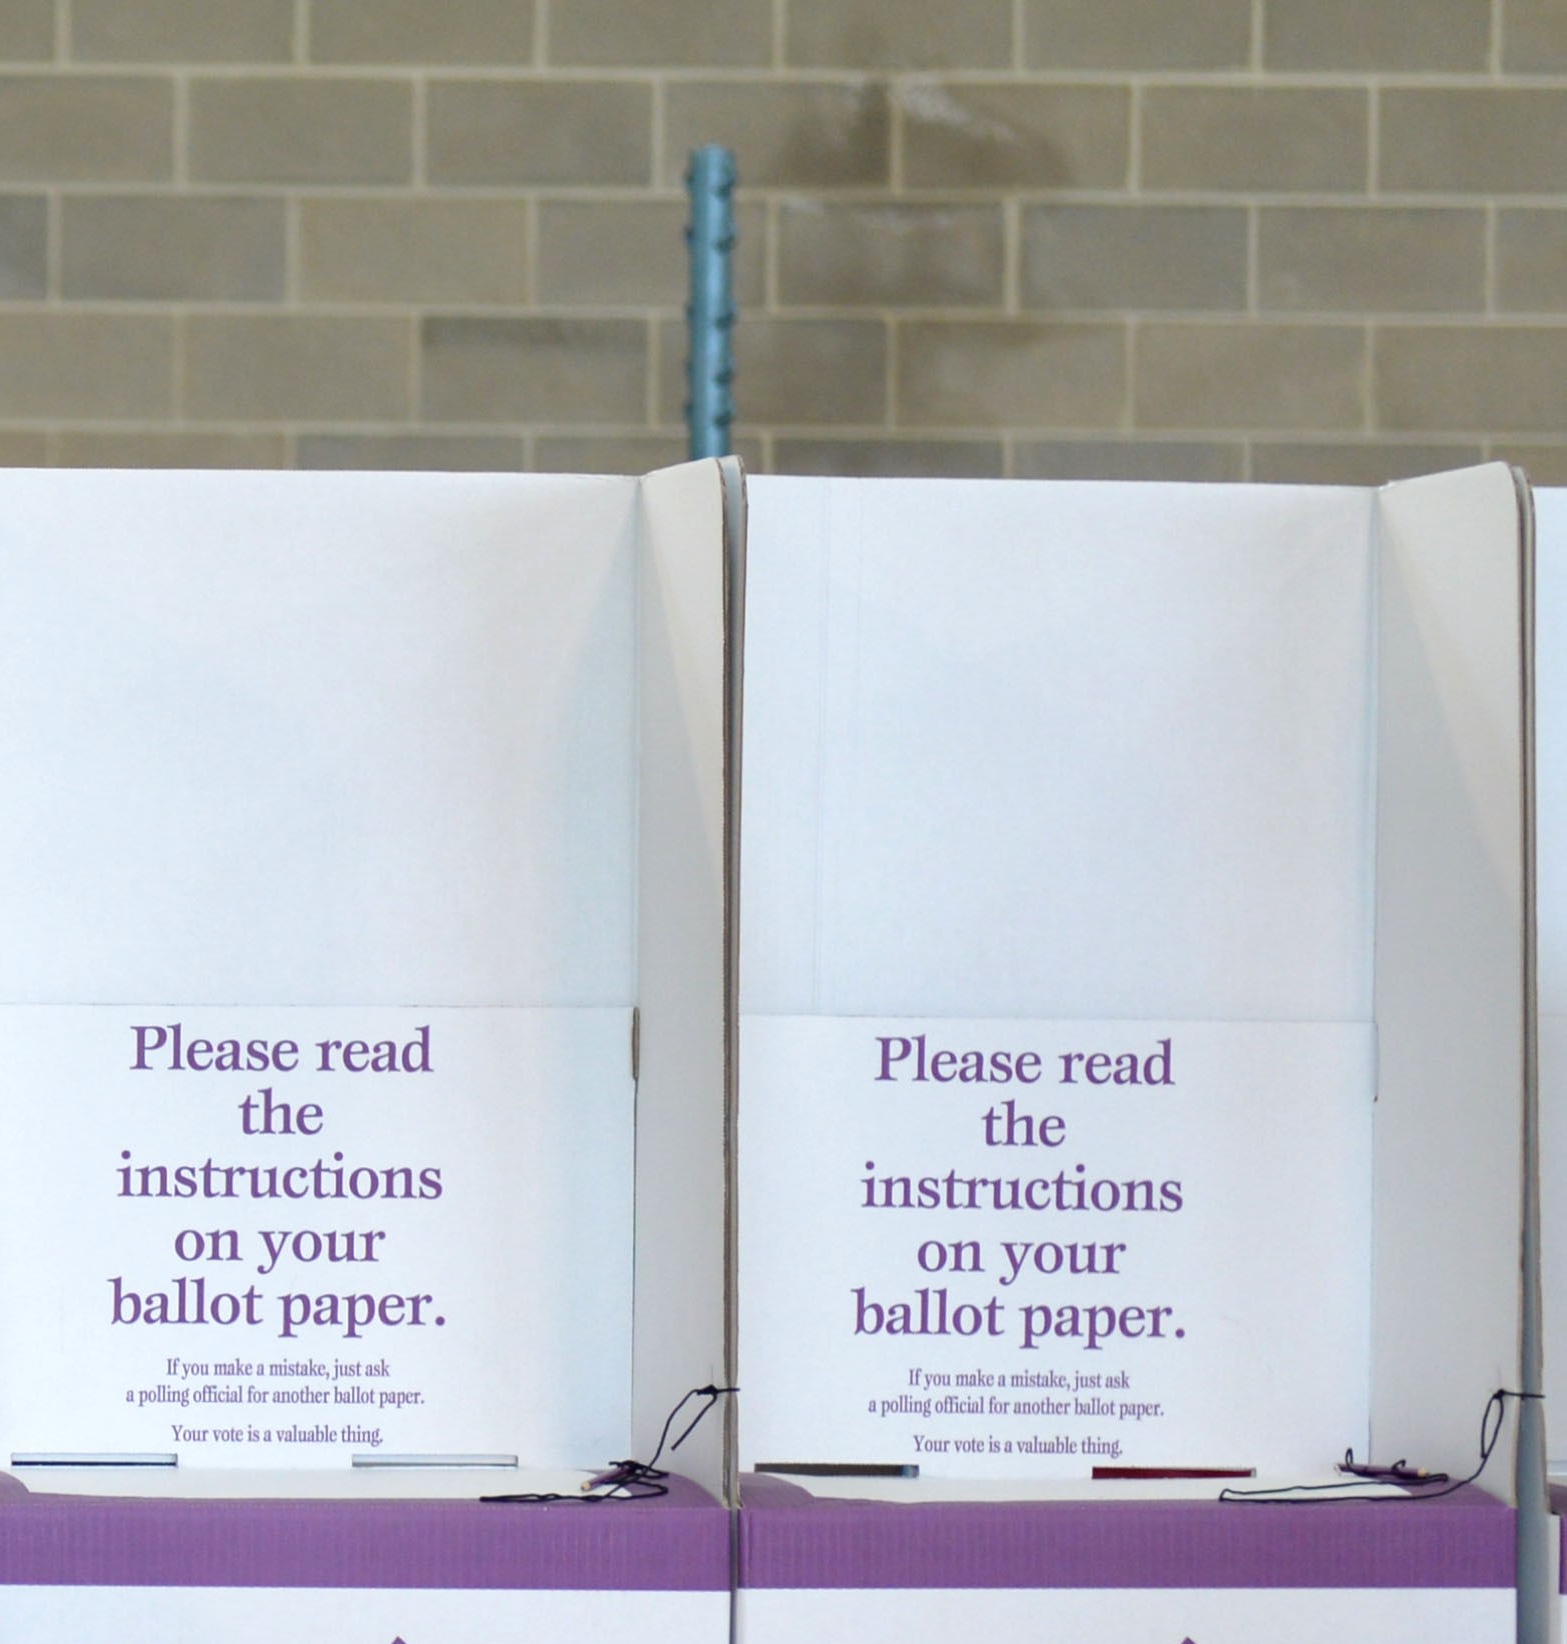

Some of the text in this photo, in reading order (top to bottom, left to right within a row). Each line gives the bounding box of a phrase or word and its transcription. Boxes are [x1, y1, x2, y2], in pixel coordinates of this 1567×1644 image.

[129, 1022, 435, 1074] Please read
[874, 1034, 1176, 1086] Please read
[237, 1086, 324, 1136] the
[981, 1098, 1066, 1148] the
[116, 1149, 443, 1200] instructions
[860, 1160, 1184, 1213] instructions
[174, 1229, 387, 1275] on your
[917, 1240, 1127, 1287] on your
[106, 1276, 446, 1339] ballot paper.
[850, 1287, 1186, 1351] ballot paper.
[166, 1357, 391, 1382] If you make a mistake, just ask
[908, 1367, 1130, 1393] If you make a mistake, just ask
[125, 1384, 425, 1409] a polling official for another ballot paper.
[867, 1394, 1165, 1421] a polling official for another ballot paper.
[171, 1423, 384, 1448] Your vote is a valuable thing.
[912, 1434, 1124, 1460] Your vote is a valuable thing.
